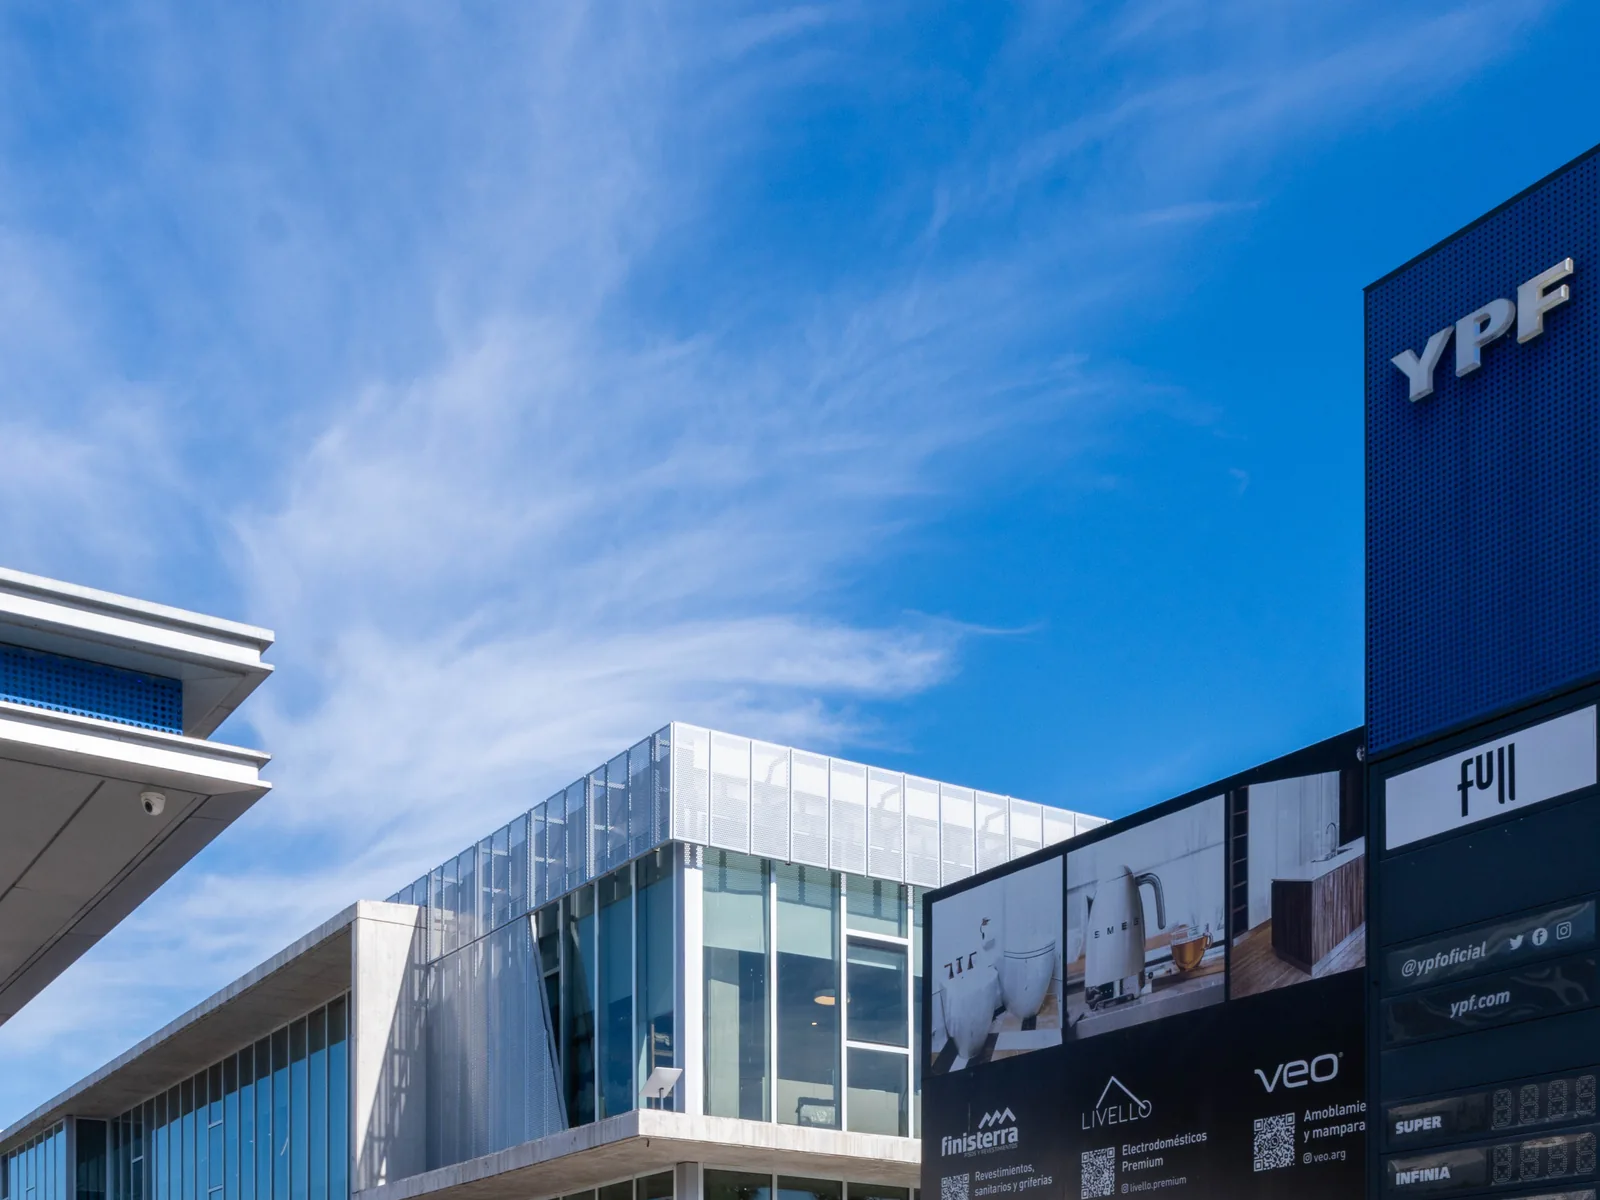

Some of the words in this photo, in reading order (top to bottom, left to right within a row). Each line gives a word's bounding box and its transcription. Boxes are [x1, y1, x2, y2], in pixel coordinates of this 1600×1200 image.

[1390, 256, 1574, 402] YPF
[1457, 742, 1516, 817] full
[1094, 917, 1140, 939] SMEG
[1401, 941, 1487, 977] @ypfoficial
[1450, 989, 1511, 1018] ypf.com
[1254, 1053, 1339, 1093] veo
[1082, 1099, 1152, 1130] LIVELLO
[1303, 1100, 1367, 1122] Amoblamie
[1303, 1130, 1310, 1143] y
[1312, 1121, 1366, 1139] mampara
[1395, 1115, 1442, 1135] SUPER
[941, 1126, 1019, 1157] finisterra
[1122, 1132, 1208, 1156] Electrodomésticos
[1122, 1157, 1164, 1172] Premium
[1313, 1150, 1346, 1162] veo.arg
[975, 1163, 1035, 1182] Revestimientos,
[1395, 1166, 1451, 1186] INFINIA
[974, 1182, 1012, 1197] sanitarios
[1012, 1181, 1018, 1192] y
[1130, 1176, 1187, 1192] livello.premium
